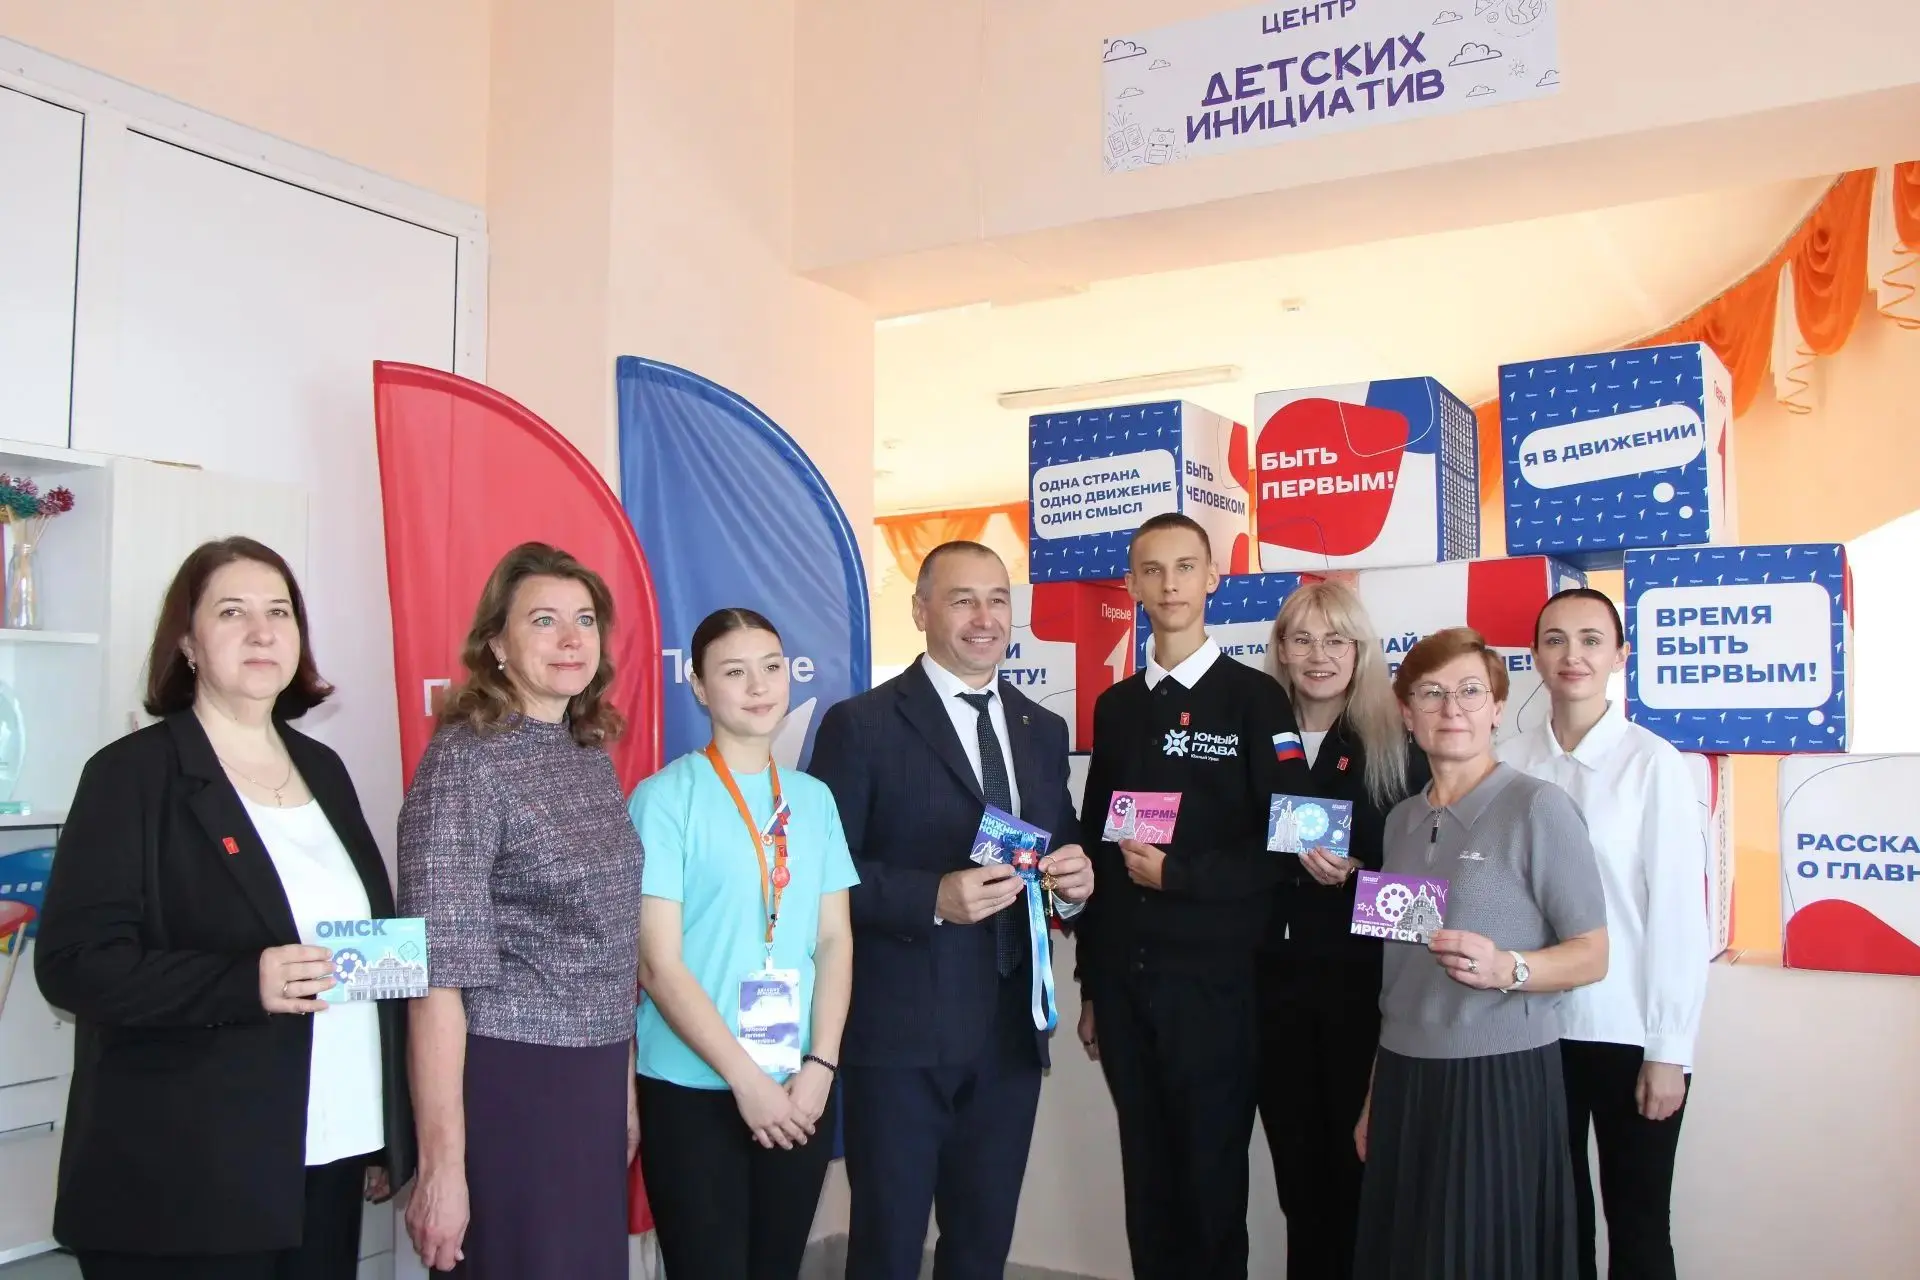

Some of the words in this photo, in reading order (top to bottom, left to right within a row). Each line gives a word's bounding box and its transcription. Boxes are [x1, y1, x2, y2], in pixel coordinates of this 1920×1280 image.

[1263, 0, 1356, 34] ЦЕНТР
[1201, 31, 1427, 107] ДЕТСКИХ
[1186, 69, 1445, 144] ИНИЦИАТИВ
[1524, 453, 1538, 467] Я
[1543, 449, 1557, 464] В
[1562, 423, 1697, 463] ДВИЖЕНИИ
[1261, 447, 1338, 471] БЫТЬ
[1039, 477, 1080, 492] ОДНА
[1083, 468, 1141, 486] СТРАНА
[1186, 460, 1214, 481] БЫТЬ
[1040, 493, 1082, 509] ОДНО
[1085, 480, 1172, 504] ДВИЖЕНИЕ
[1262, 471, 1395, 500] ПЕРВЫМ!
[1186, 485, 1246, 516] ЧЕЛОВЕКОМ
[1041, 510, 1083, 525] ОДИН
[1086, 502, 1143, 518] СМЫСЛ
[1101, 603, 1132, 622] Первые
[1656, 605, 1772, 627] ВРЕМЯ
[1656, 635, 1749, 656] БЫТЬ
[1657, 662, 1817, 684] ПЕРВЫМ!
[1191, 742, 1238, 756] ГЛАВА
[1194, 732, 1239, 746] ЮНЫЙ
[1136, 809, 1177, 819] ПЕРМЬ
[1797, 861, 1819, 878] О
[315, 919, 388, 938] ОМСК
[1350, 922, 1418, 942] ИРКУТСК
